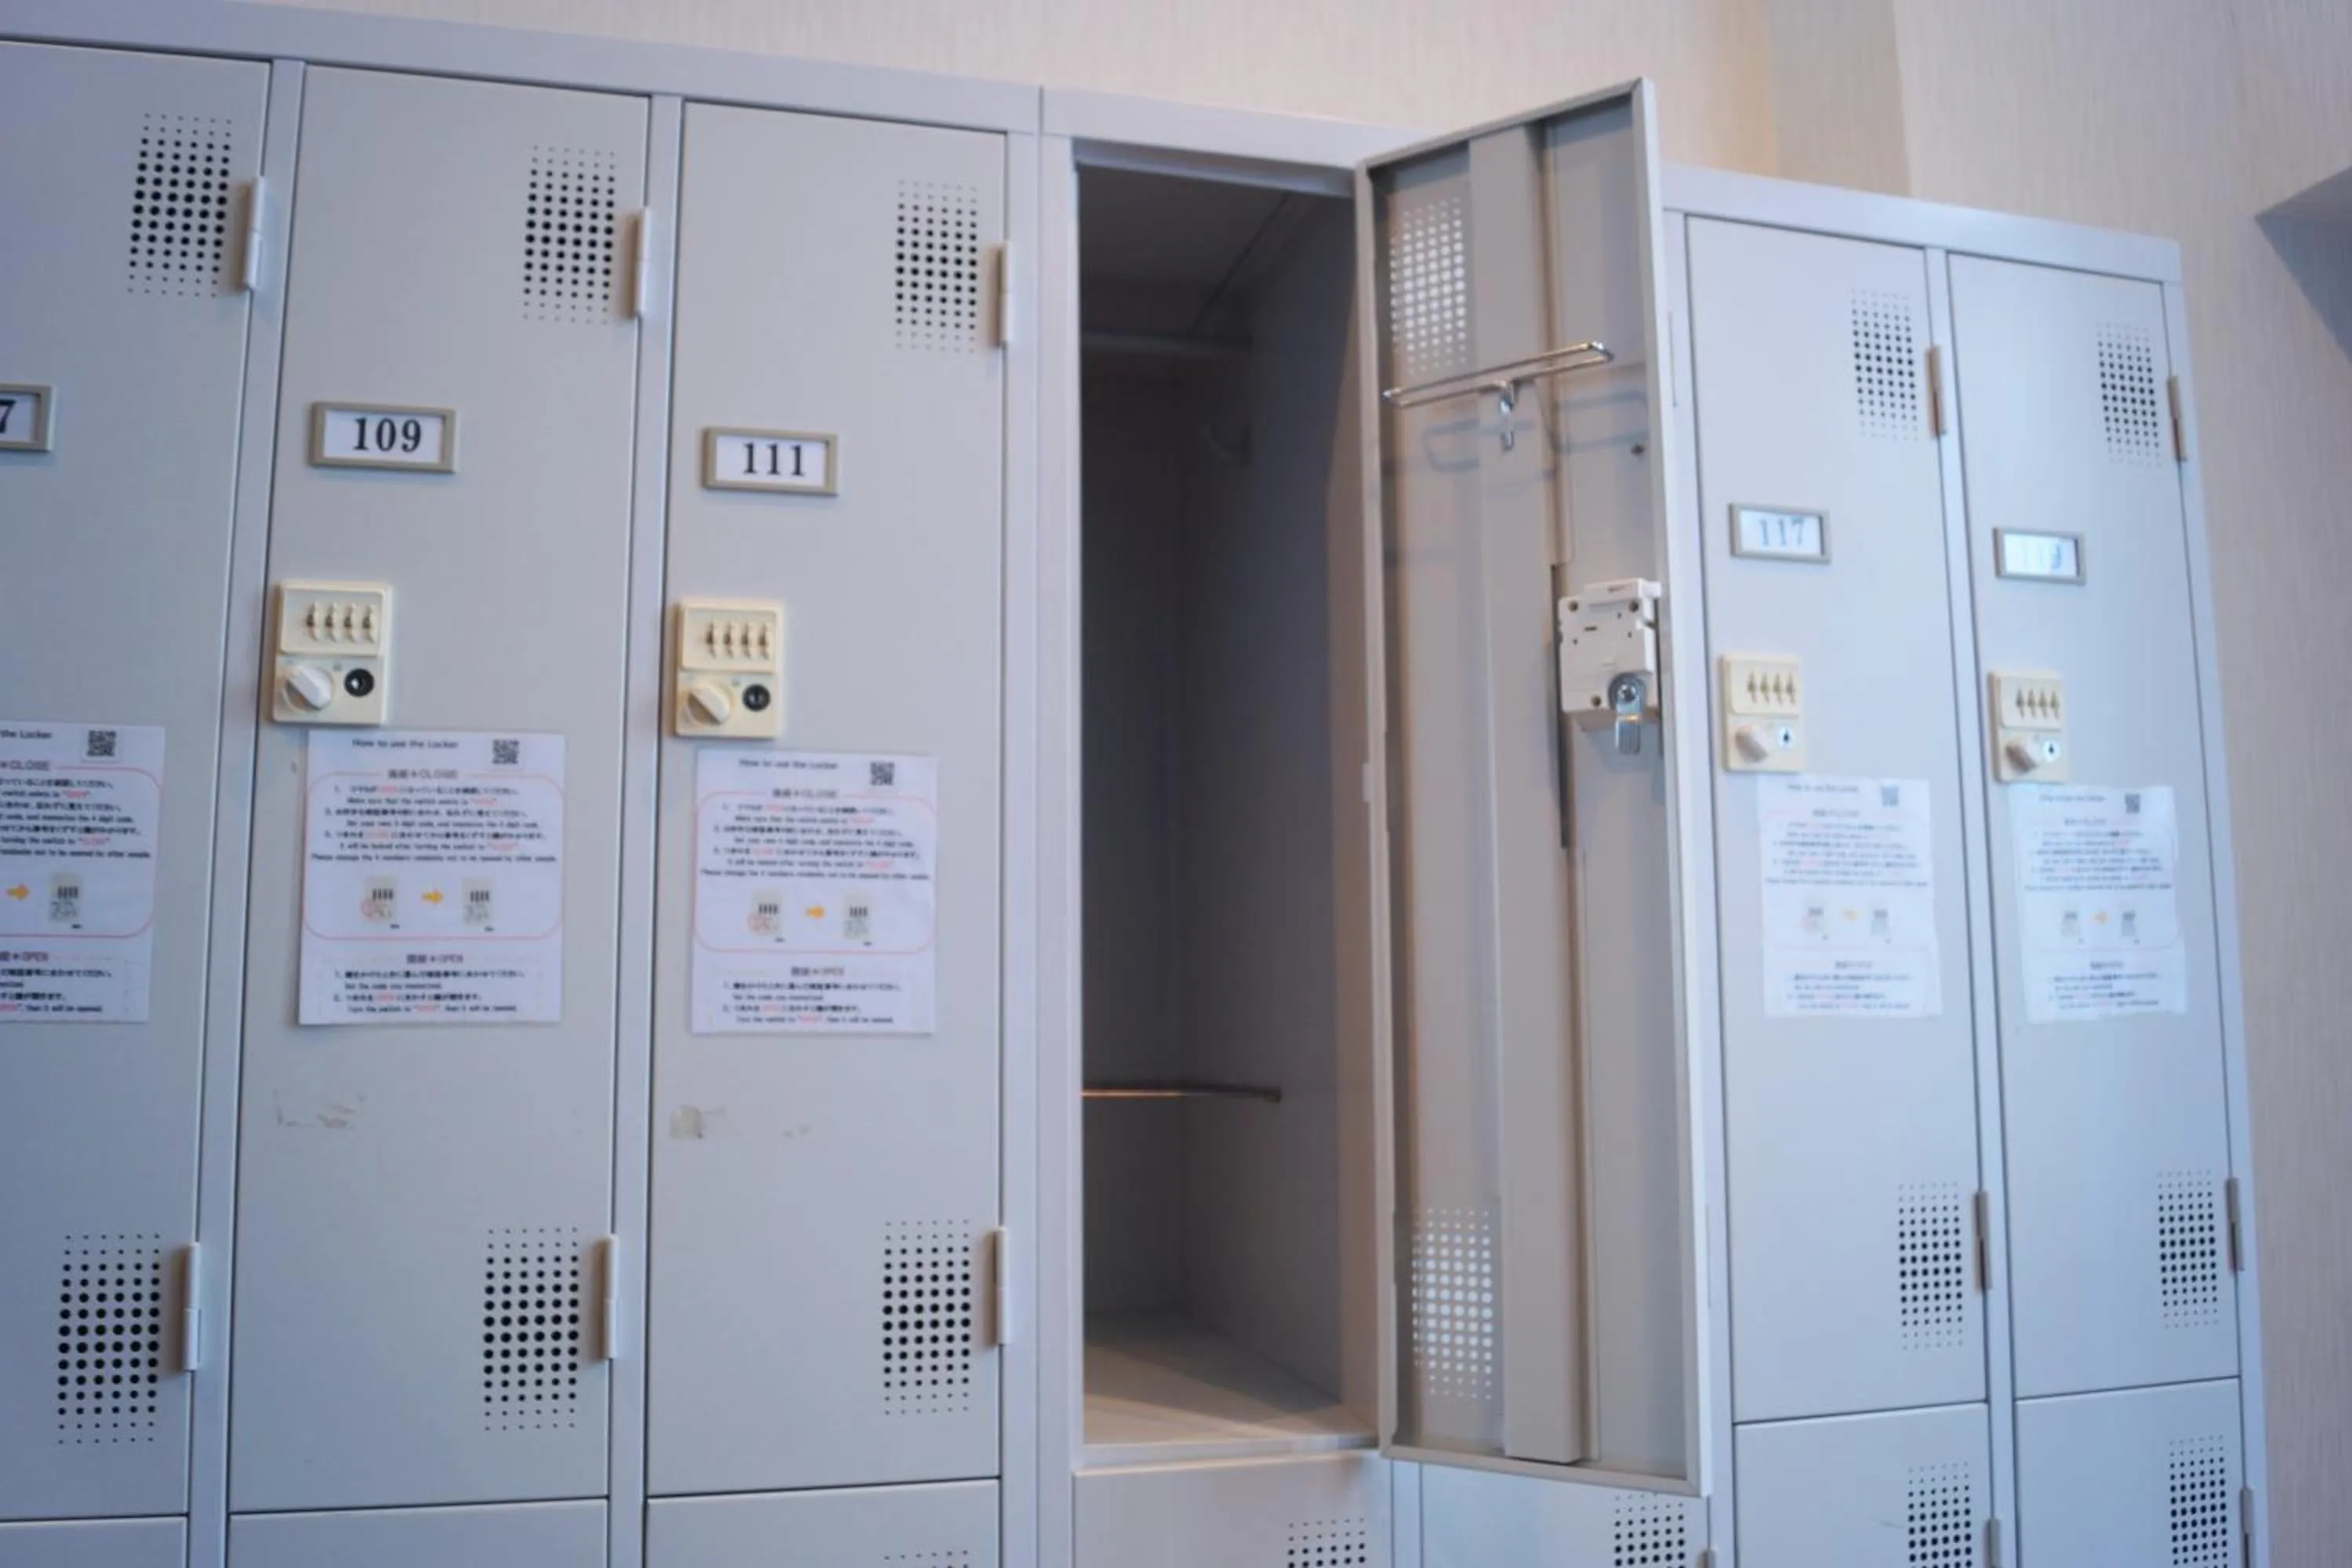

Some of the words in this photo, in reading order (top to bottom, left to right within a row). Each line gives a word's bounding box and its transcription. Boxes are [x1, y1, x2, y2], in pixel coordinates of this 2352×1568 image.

[353, 418, 422, 452] 109
[743, 442, 804, 477] 111
[1759, 517, 1805, 546] 117
